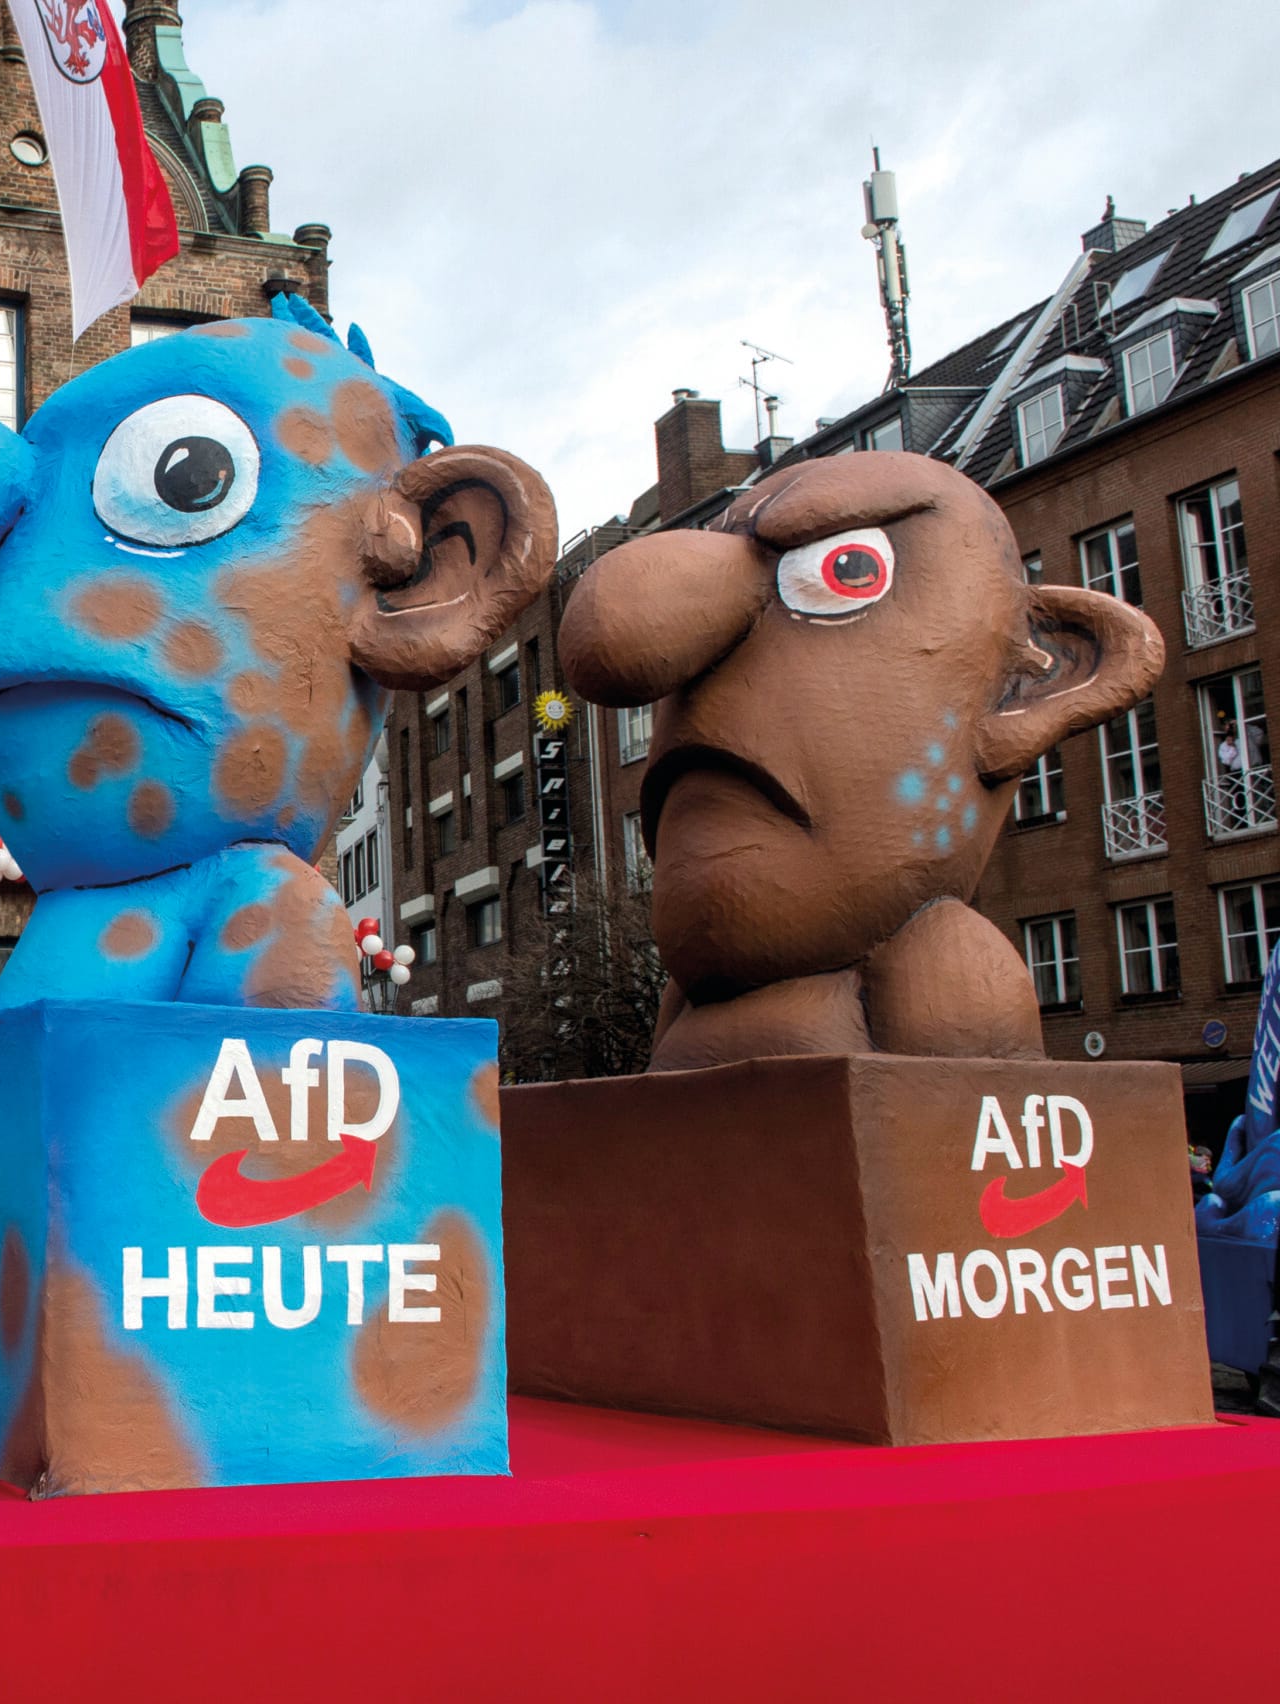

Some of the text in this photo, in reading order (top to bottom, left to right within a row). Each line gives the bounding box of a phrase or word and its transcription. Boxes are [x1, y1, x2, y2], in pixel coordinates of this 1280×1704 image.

[190, 1038, 400, 1141] AfD
[971, 1094, 1093, 1171] AfD
[122, 1243, 441, 1330] HEUTE
[907, 1244, 1172, 1321] MORGEN
